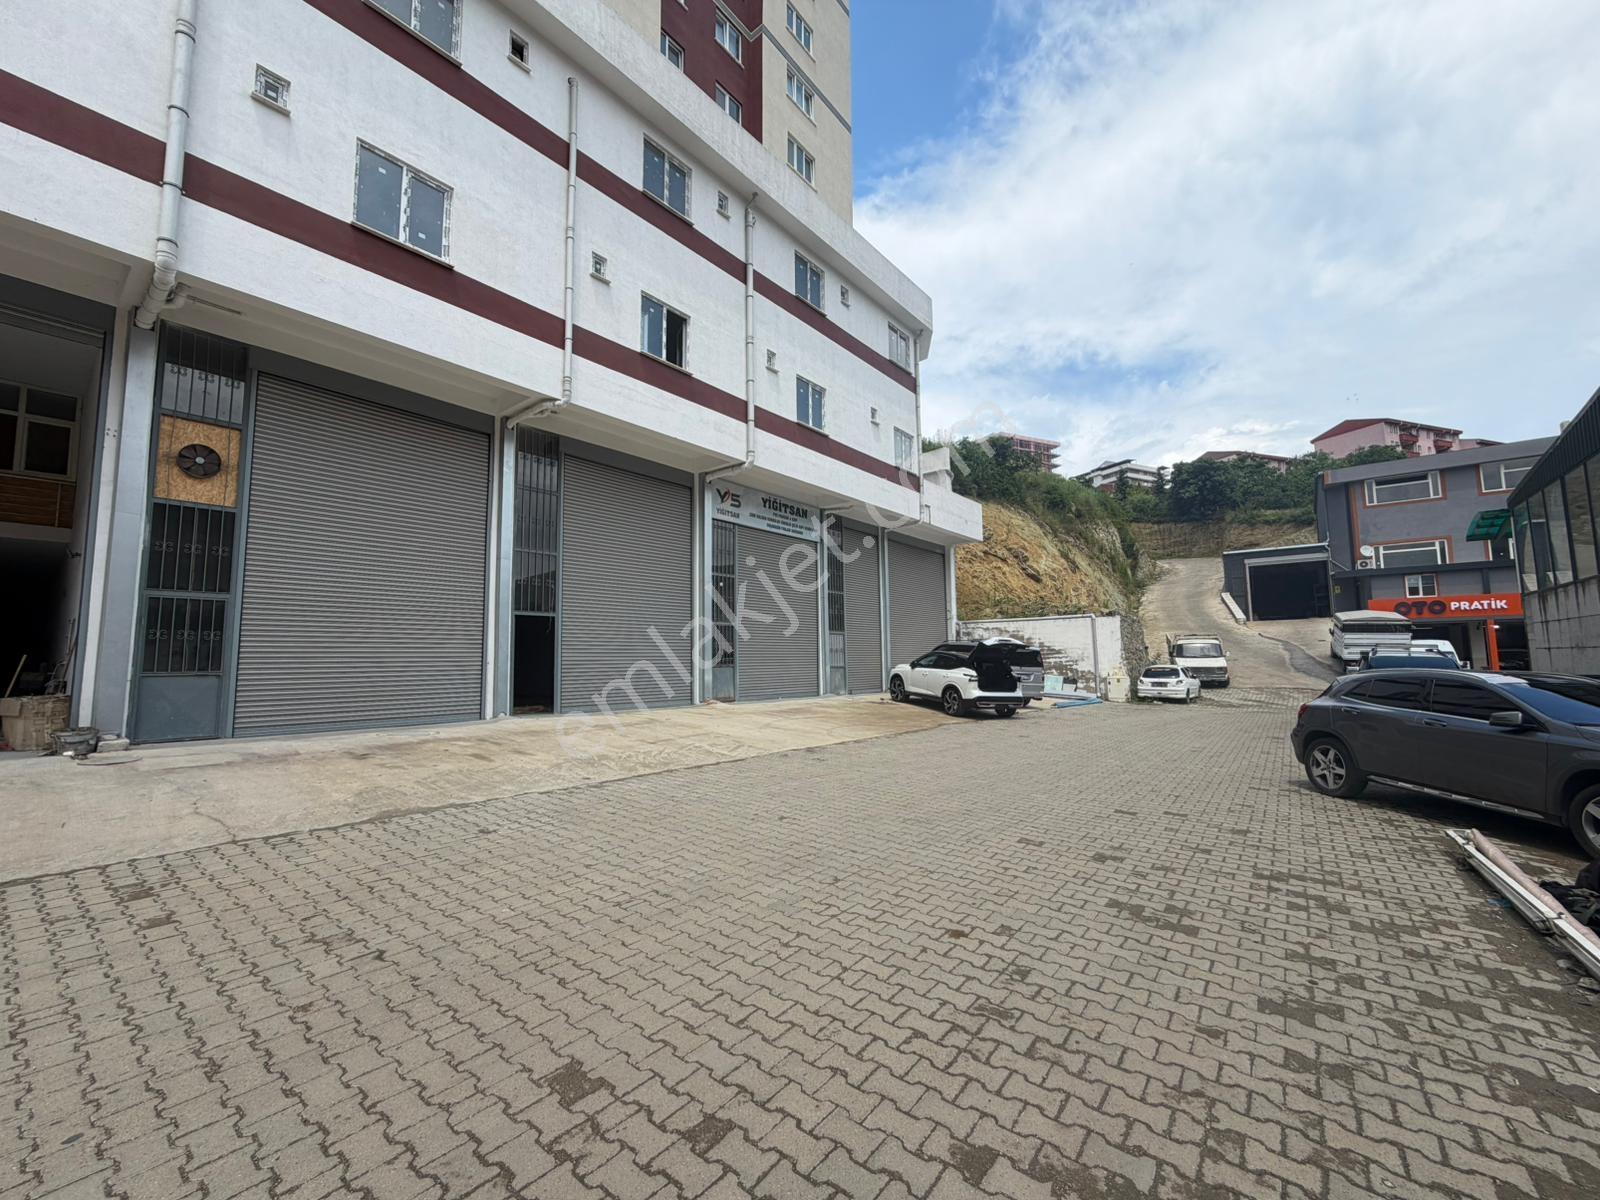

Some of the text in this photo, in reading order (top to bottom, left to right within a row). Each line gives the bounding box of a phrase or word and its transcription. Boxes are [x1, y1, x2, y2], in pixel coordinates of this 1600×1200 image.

[761, 496, 808, 519] YİĞİTSAN
[1395, 598, 1508, 616] OTO PRATİK
